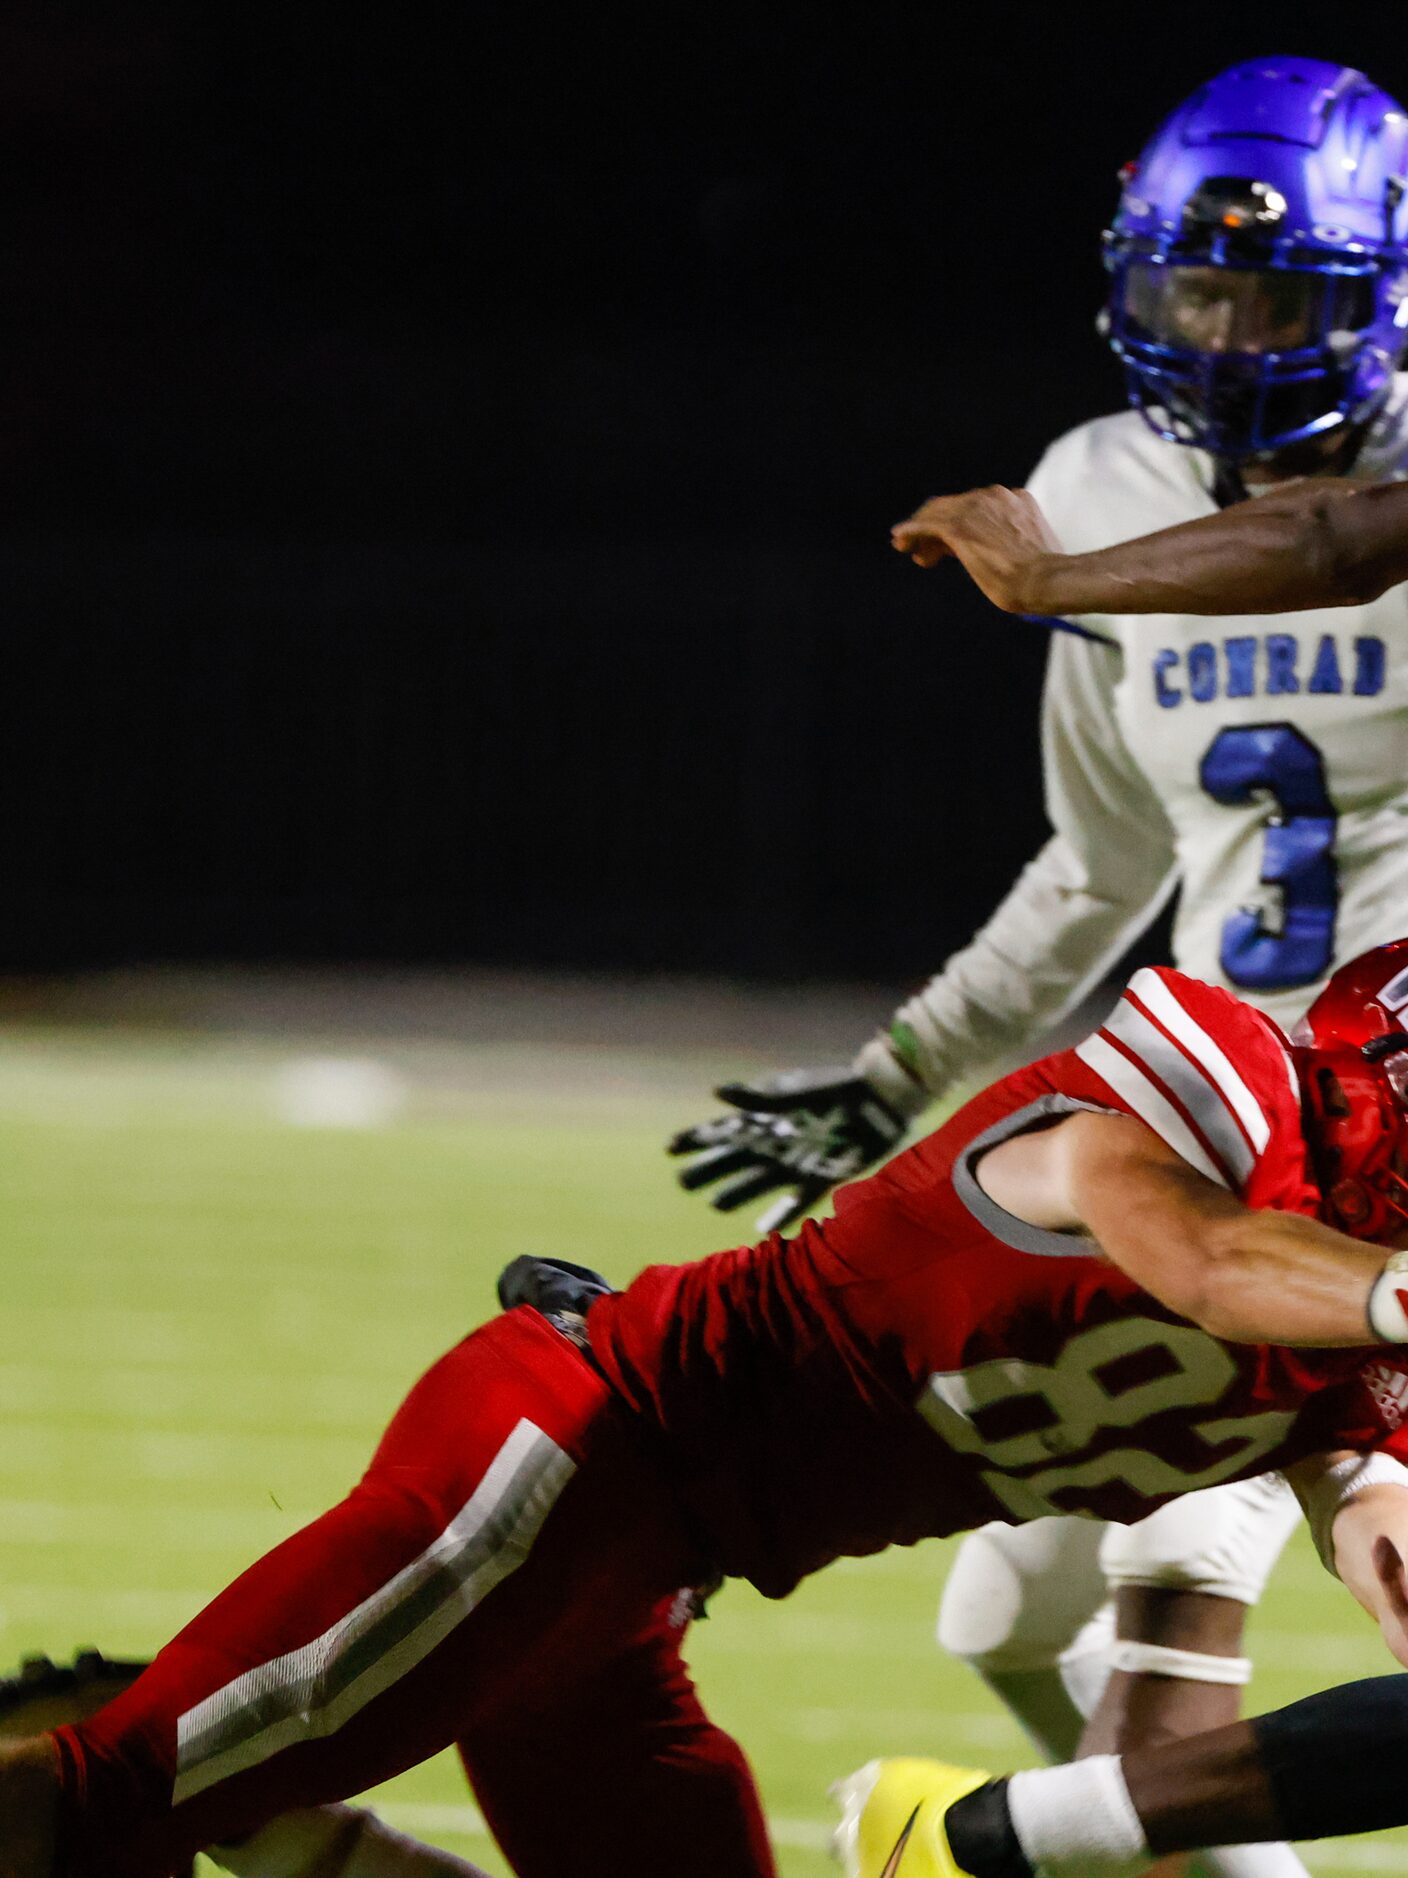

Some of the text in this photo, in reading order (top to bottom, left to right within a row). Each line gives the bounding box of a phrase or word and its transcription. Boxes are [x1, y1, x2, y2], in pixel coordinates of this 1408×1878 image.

[1153, 633, 1386, 709] CONRAD
[1198, 721, 1338, 982] 3
[915, 1316, 1299, 1523] 82
